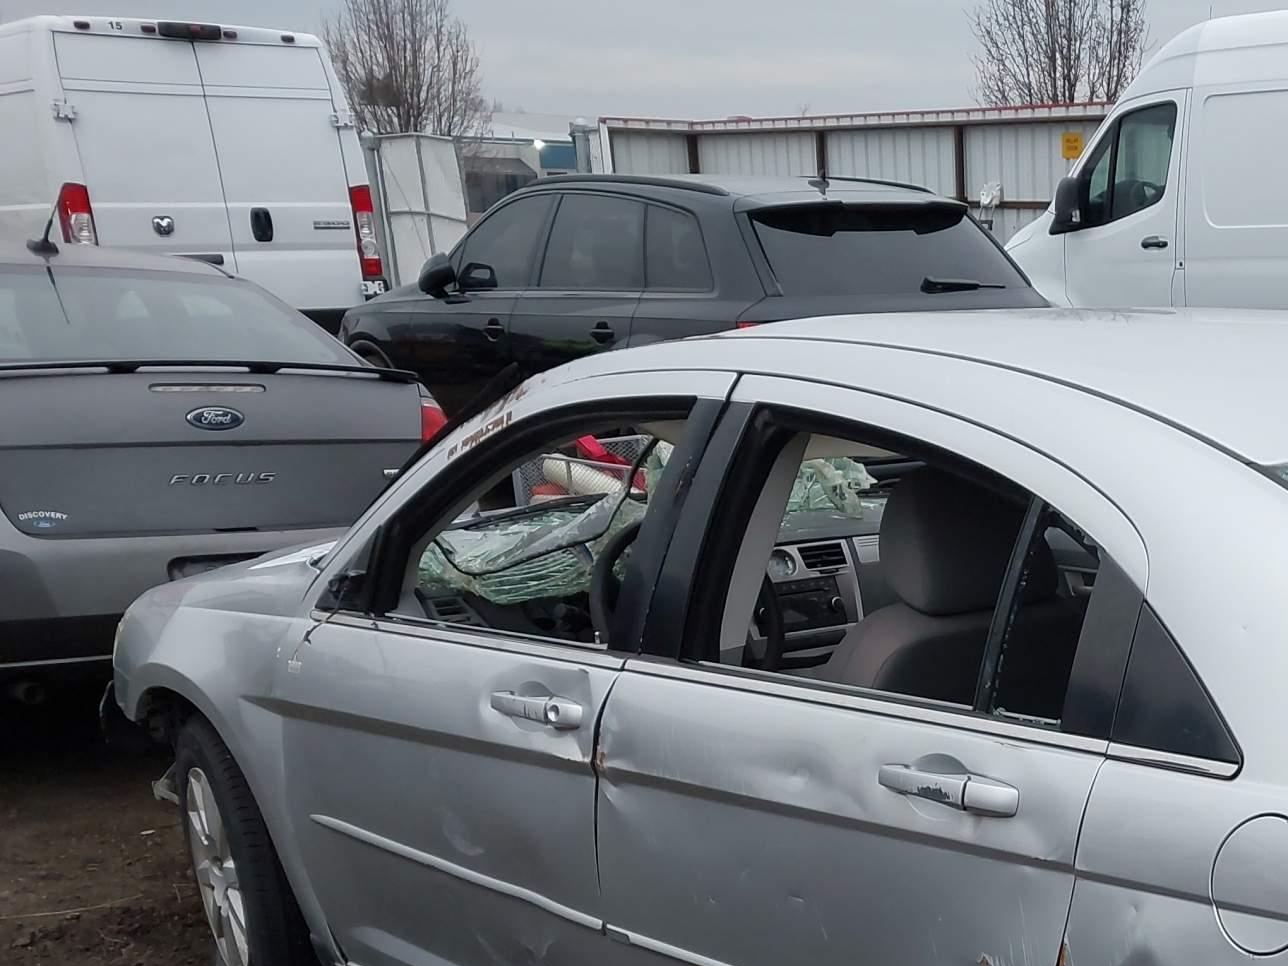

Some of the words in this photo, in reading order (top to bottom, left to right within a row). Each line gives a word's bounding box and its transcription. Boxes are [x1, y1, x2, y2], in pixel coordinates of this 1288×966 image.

[108, 21, 123, 30] 15
[201, 410, 232, 424] Ford
[169, 472, 277, 485] FOCUS
[18, 510, 68, 520] DISCOVERY
